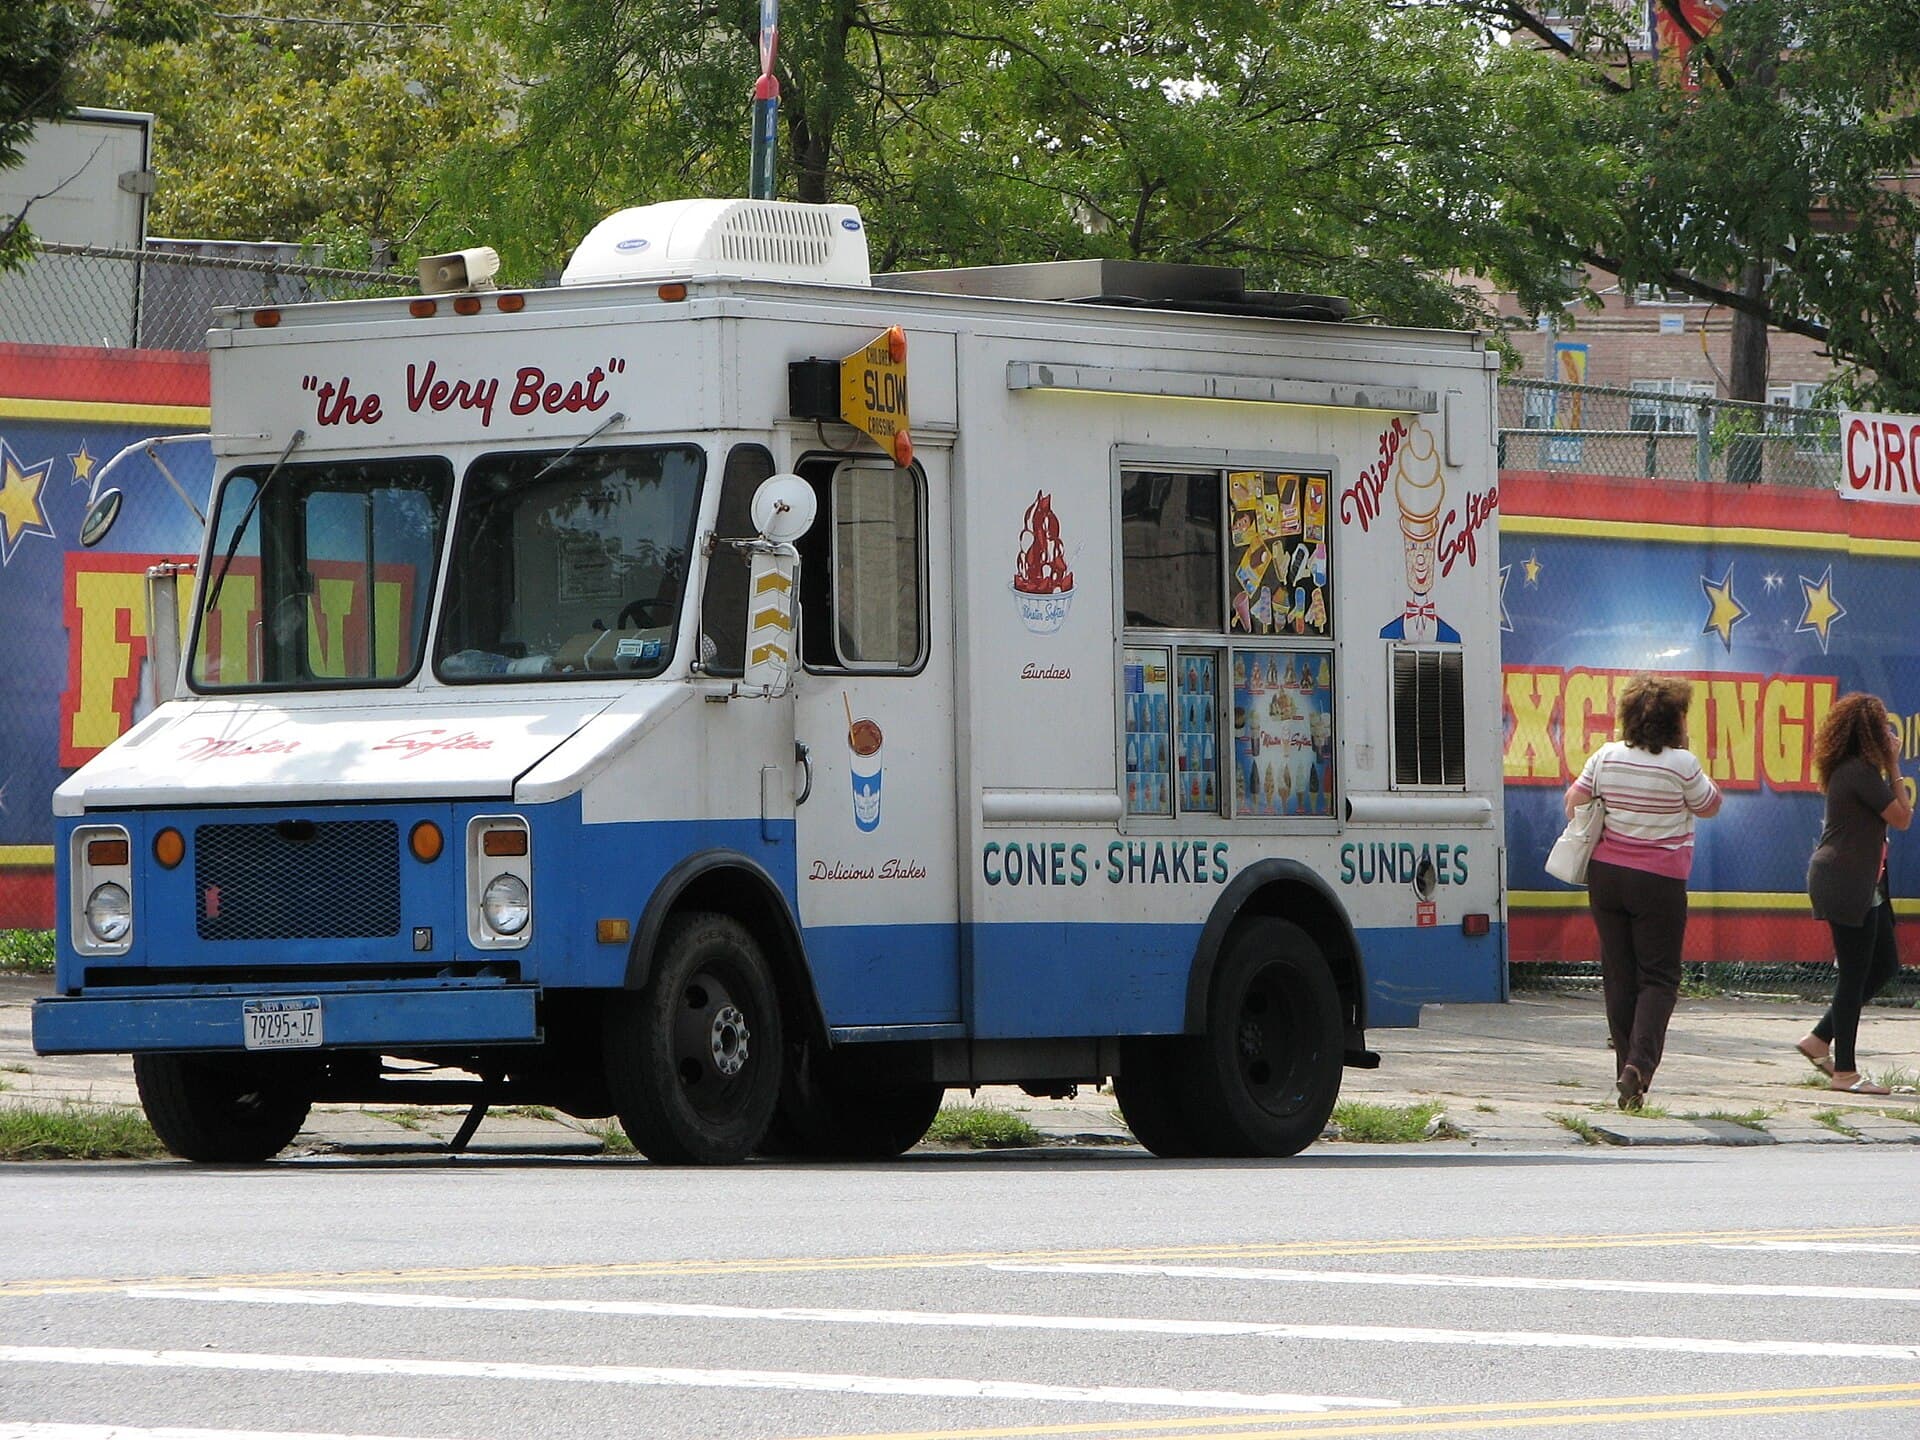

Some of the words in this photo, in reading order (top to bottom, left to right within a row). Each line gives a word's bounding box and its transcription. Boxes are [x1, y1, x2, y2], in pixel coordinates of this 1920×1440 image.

[866, 346, 894, 367] CHILDRE
[302, 375, 383, 426] "the
[406, 360, 499, 427] Very
[510, 357, 625, 415] Best"
[864, 369, 906, 416] SLOW
[868, 416, 896, 437] CROSSING
[1341, 417, 1408, 533] Mister
[1438, 486, 1499, 578] Softee
[1021, 662, 1071, 680] Sundaes
[177, 737, 301, 761] Mister
[372, 729, 494, 760] Softee
[809, 860, 875, 881] Delicious
[878, 858, 927, 880] Shakes
[983, 840, 1088, 886] CONES
[1107, 840, 1229, 885] SHAKES
[251, 1013, 290, 1039] 79295
[300, 1012, 314, 1036] JZ
